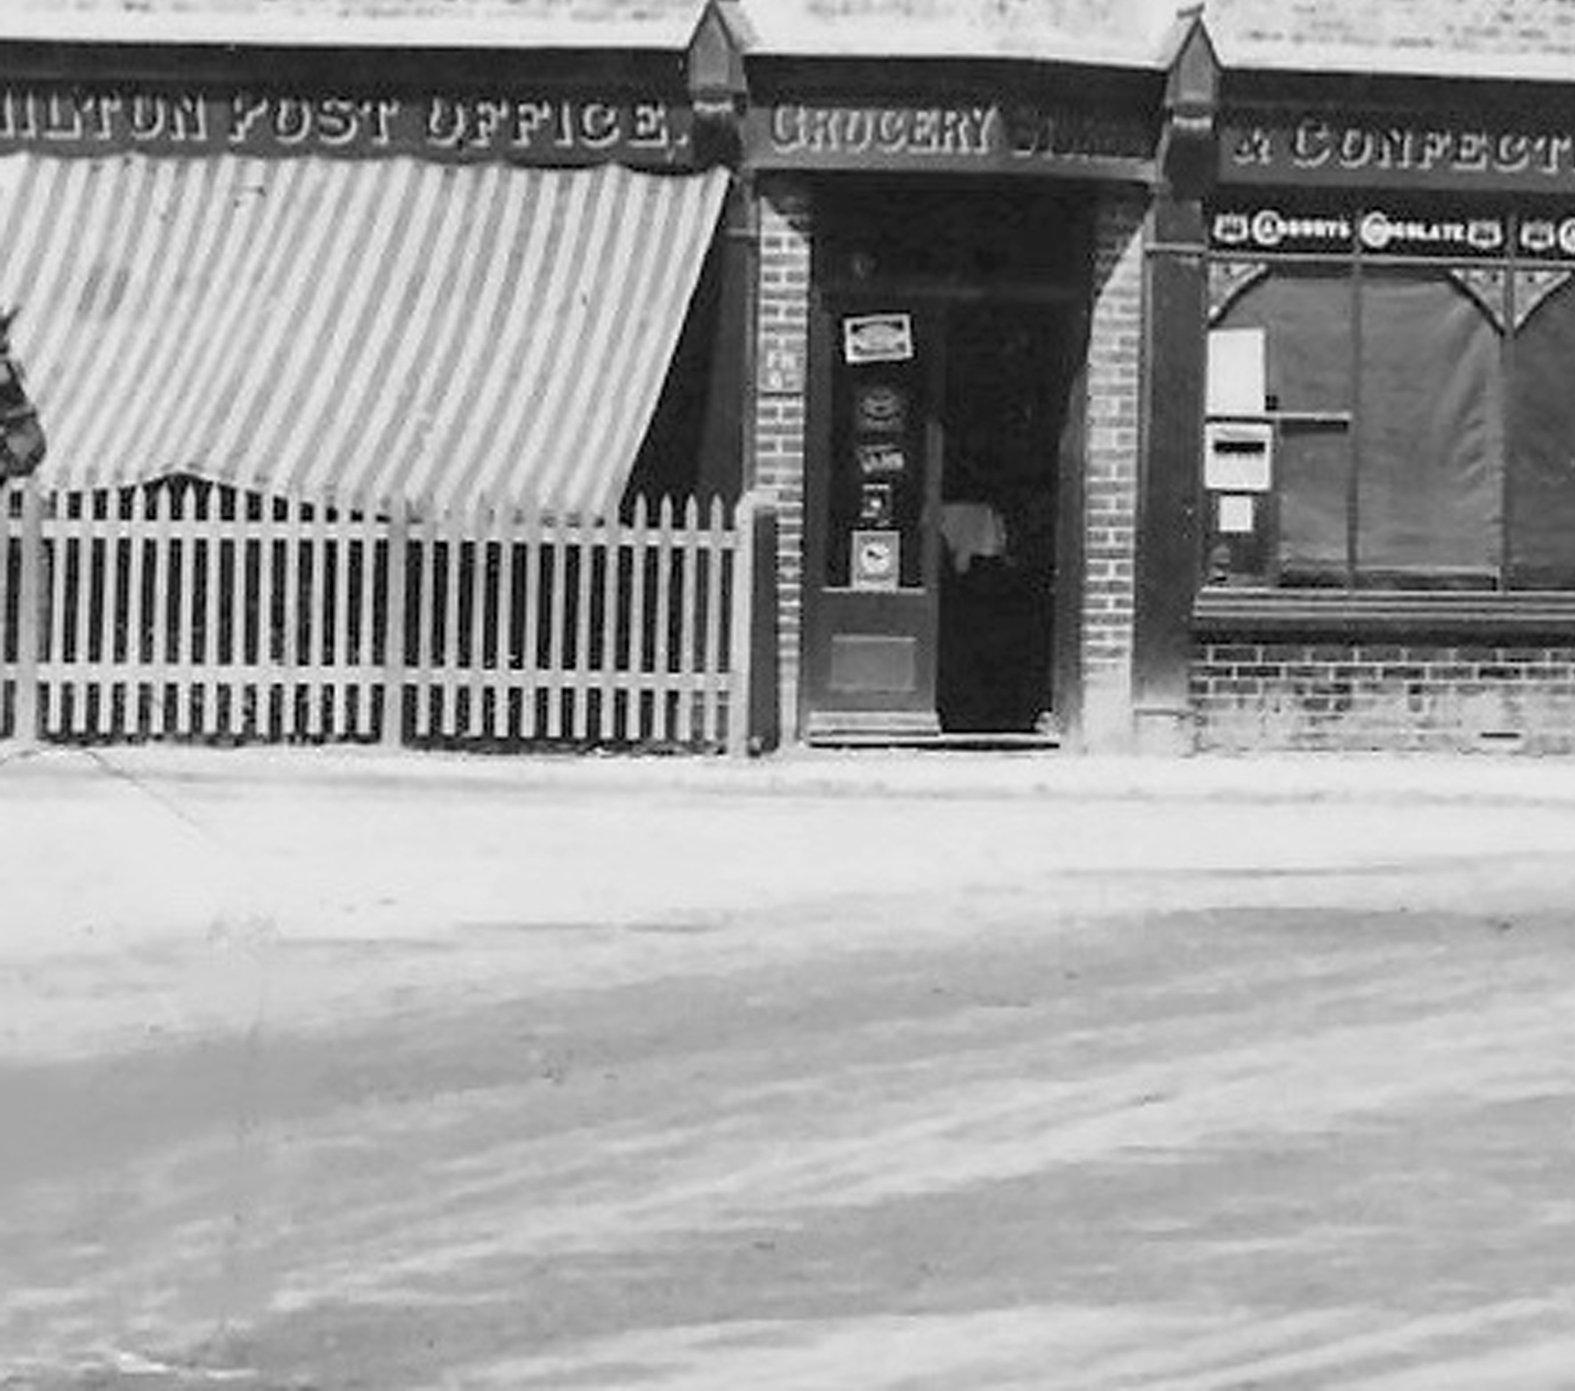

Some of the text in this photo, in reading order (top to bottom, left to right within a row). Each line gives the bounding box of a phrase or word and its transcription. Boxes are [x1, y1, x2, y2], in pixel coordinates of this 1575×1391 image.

[228, 96, 399, 146] POST
[771, 105, 998, 154] GROCERY
[1232, 126, 1272, 165] &
